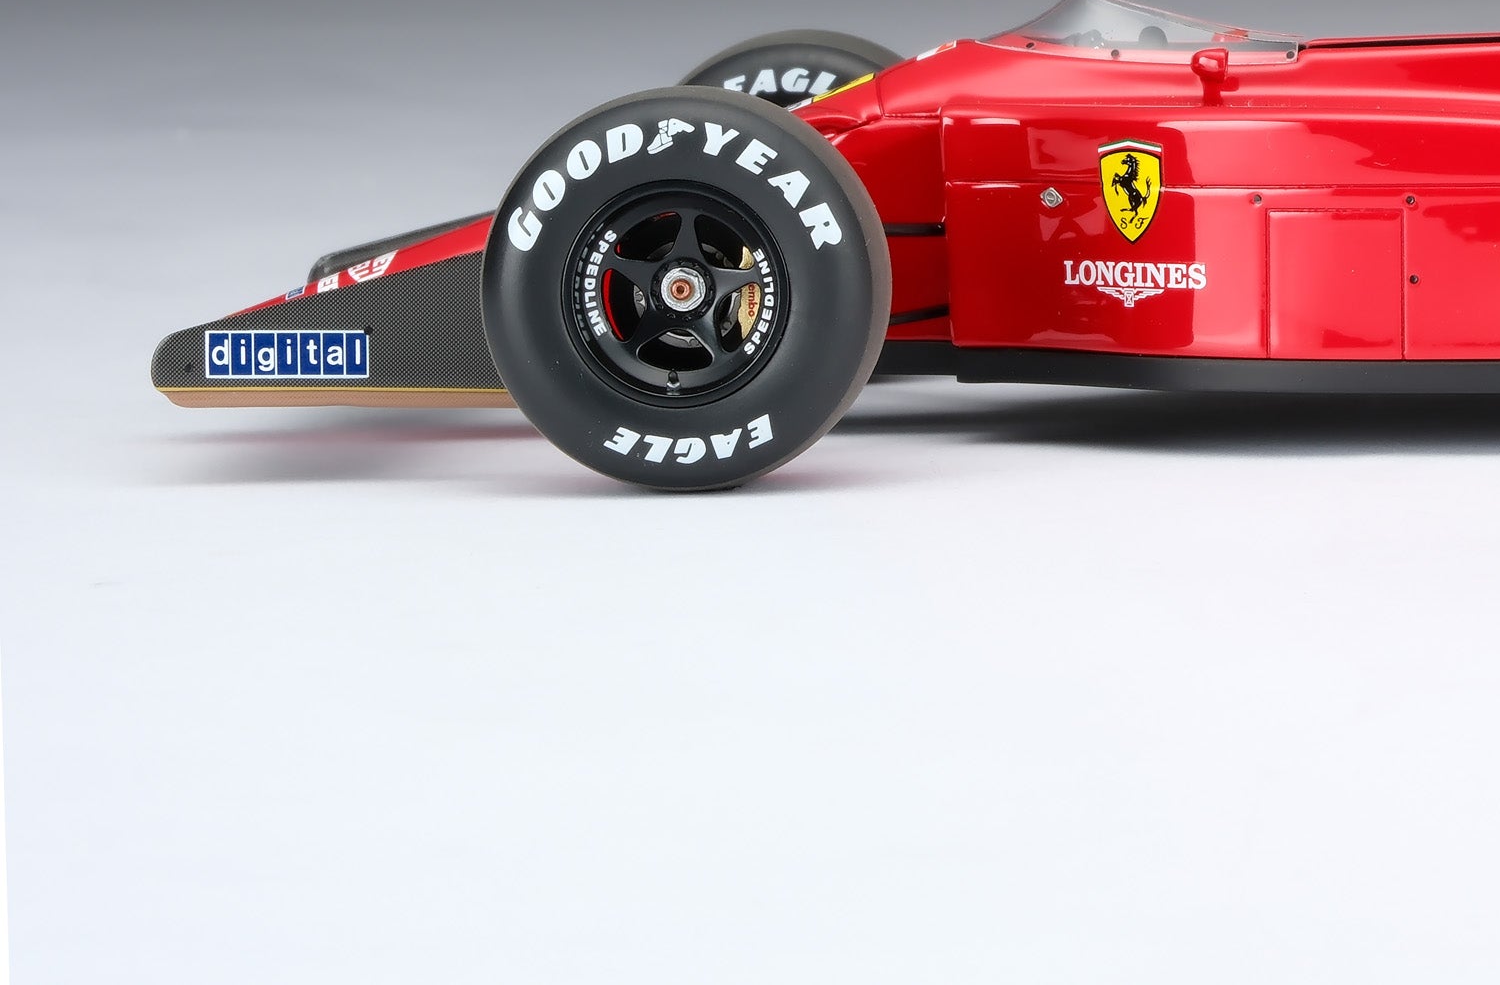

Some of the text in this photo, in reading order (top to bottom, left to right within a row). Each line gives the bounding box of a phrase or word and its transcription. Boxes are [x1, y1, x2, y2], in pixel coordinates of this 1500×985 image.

[584, 230, 617, 336] SPEEDLINE
[1064, 260, 1207, 290] LONGINES
[744, 248, 774, 354] SPEEDLINE
[211, 339, 361, 372] digital
[604, 414, 774, 464] EAGLE
